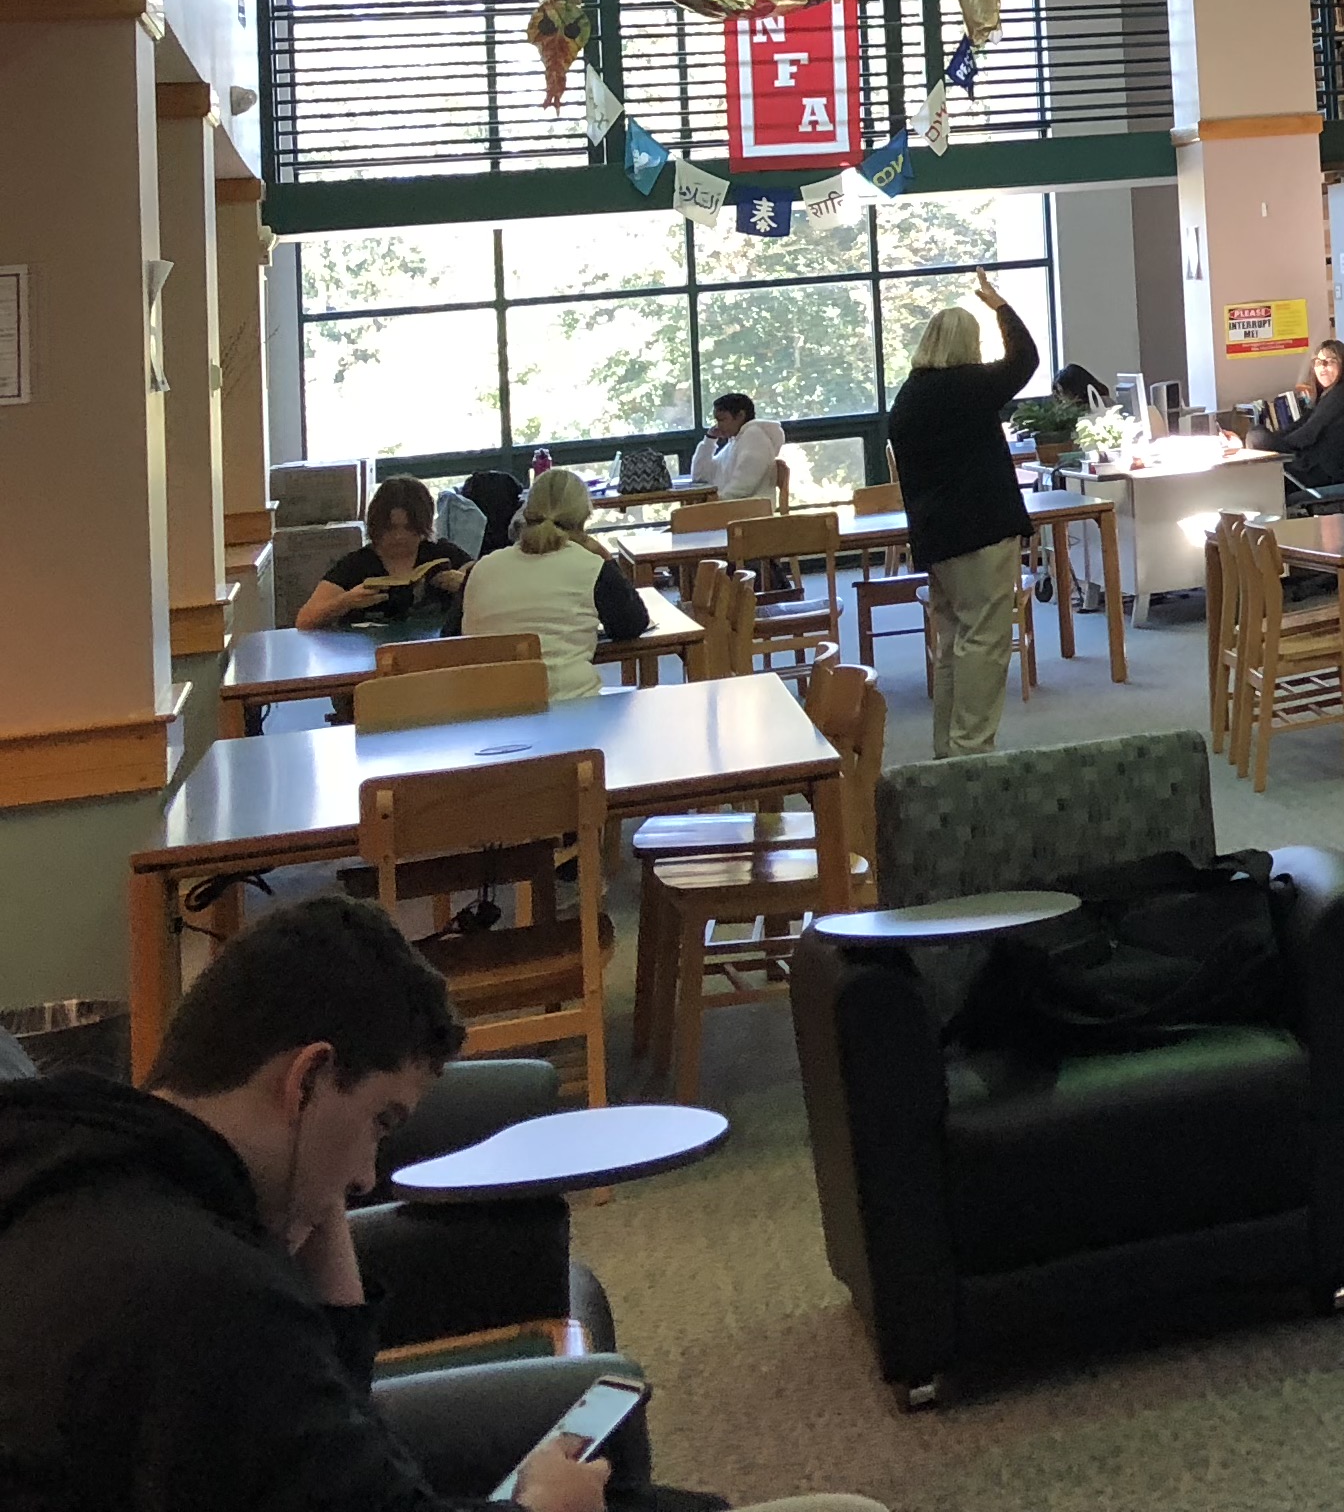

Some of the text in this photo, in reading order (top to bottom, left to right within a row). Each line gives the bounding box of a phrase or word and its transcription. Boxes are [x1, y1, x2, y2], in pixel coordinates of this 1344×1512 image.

[753, 15, 786, 43] N
[773, 52, 809, 87] F
[798, 97, 834, 132] A
[1234, 308, 1266, 317] PLEASE
[1229, 319, 1271, 331] INTERRUPT
[1243, 330, 1258, 339] ME!
